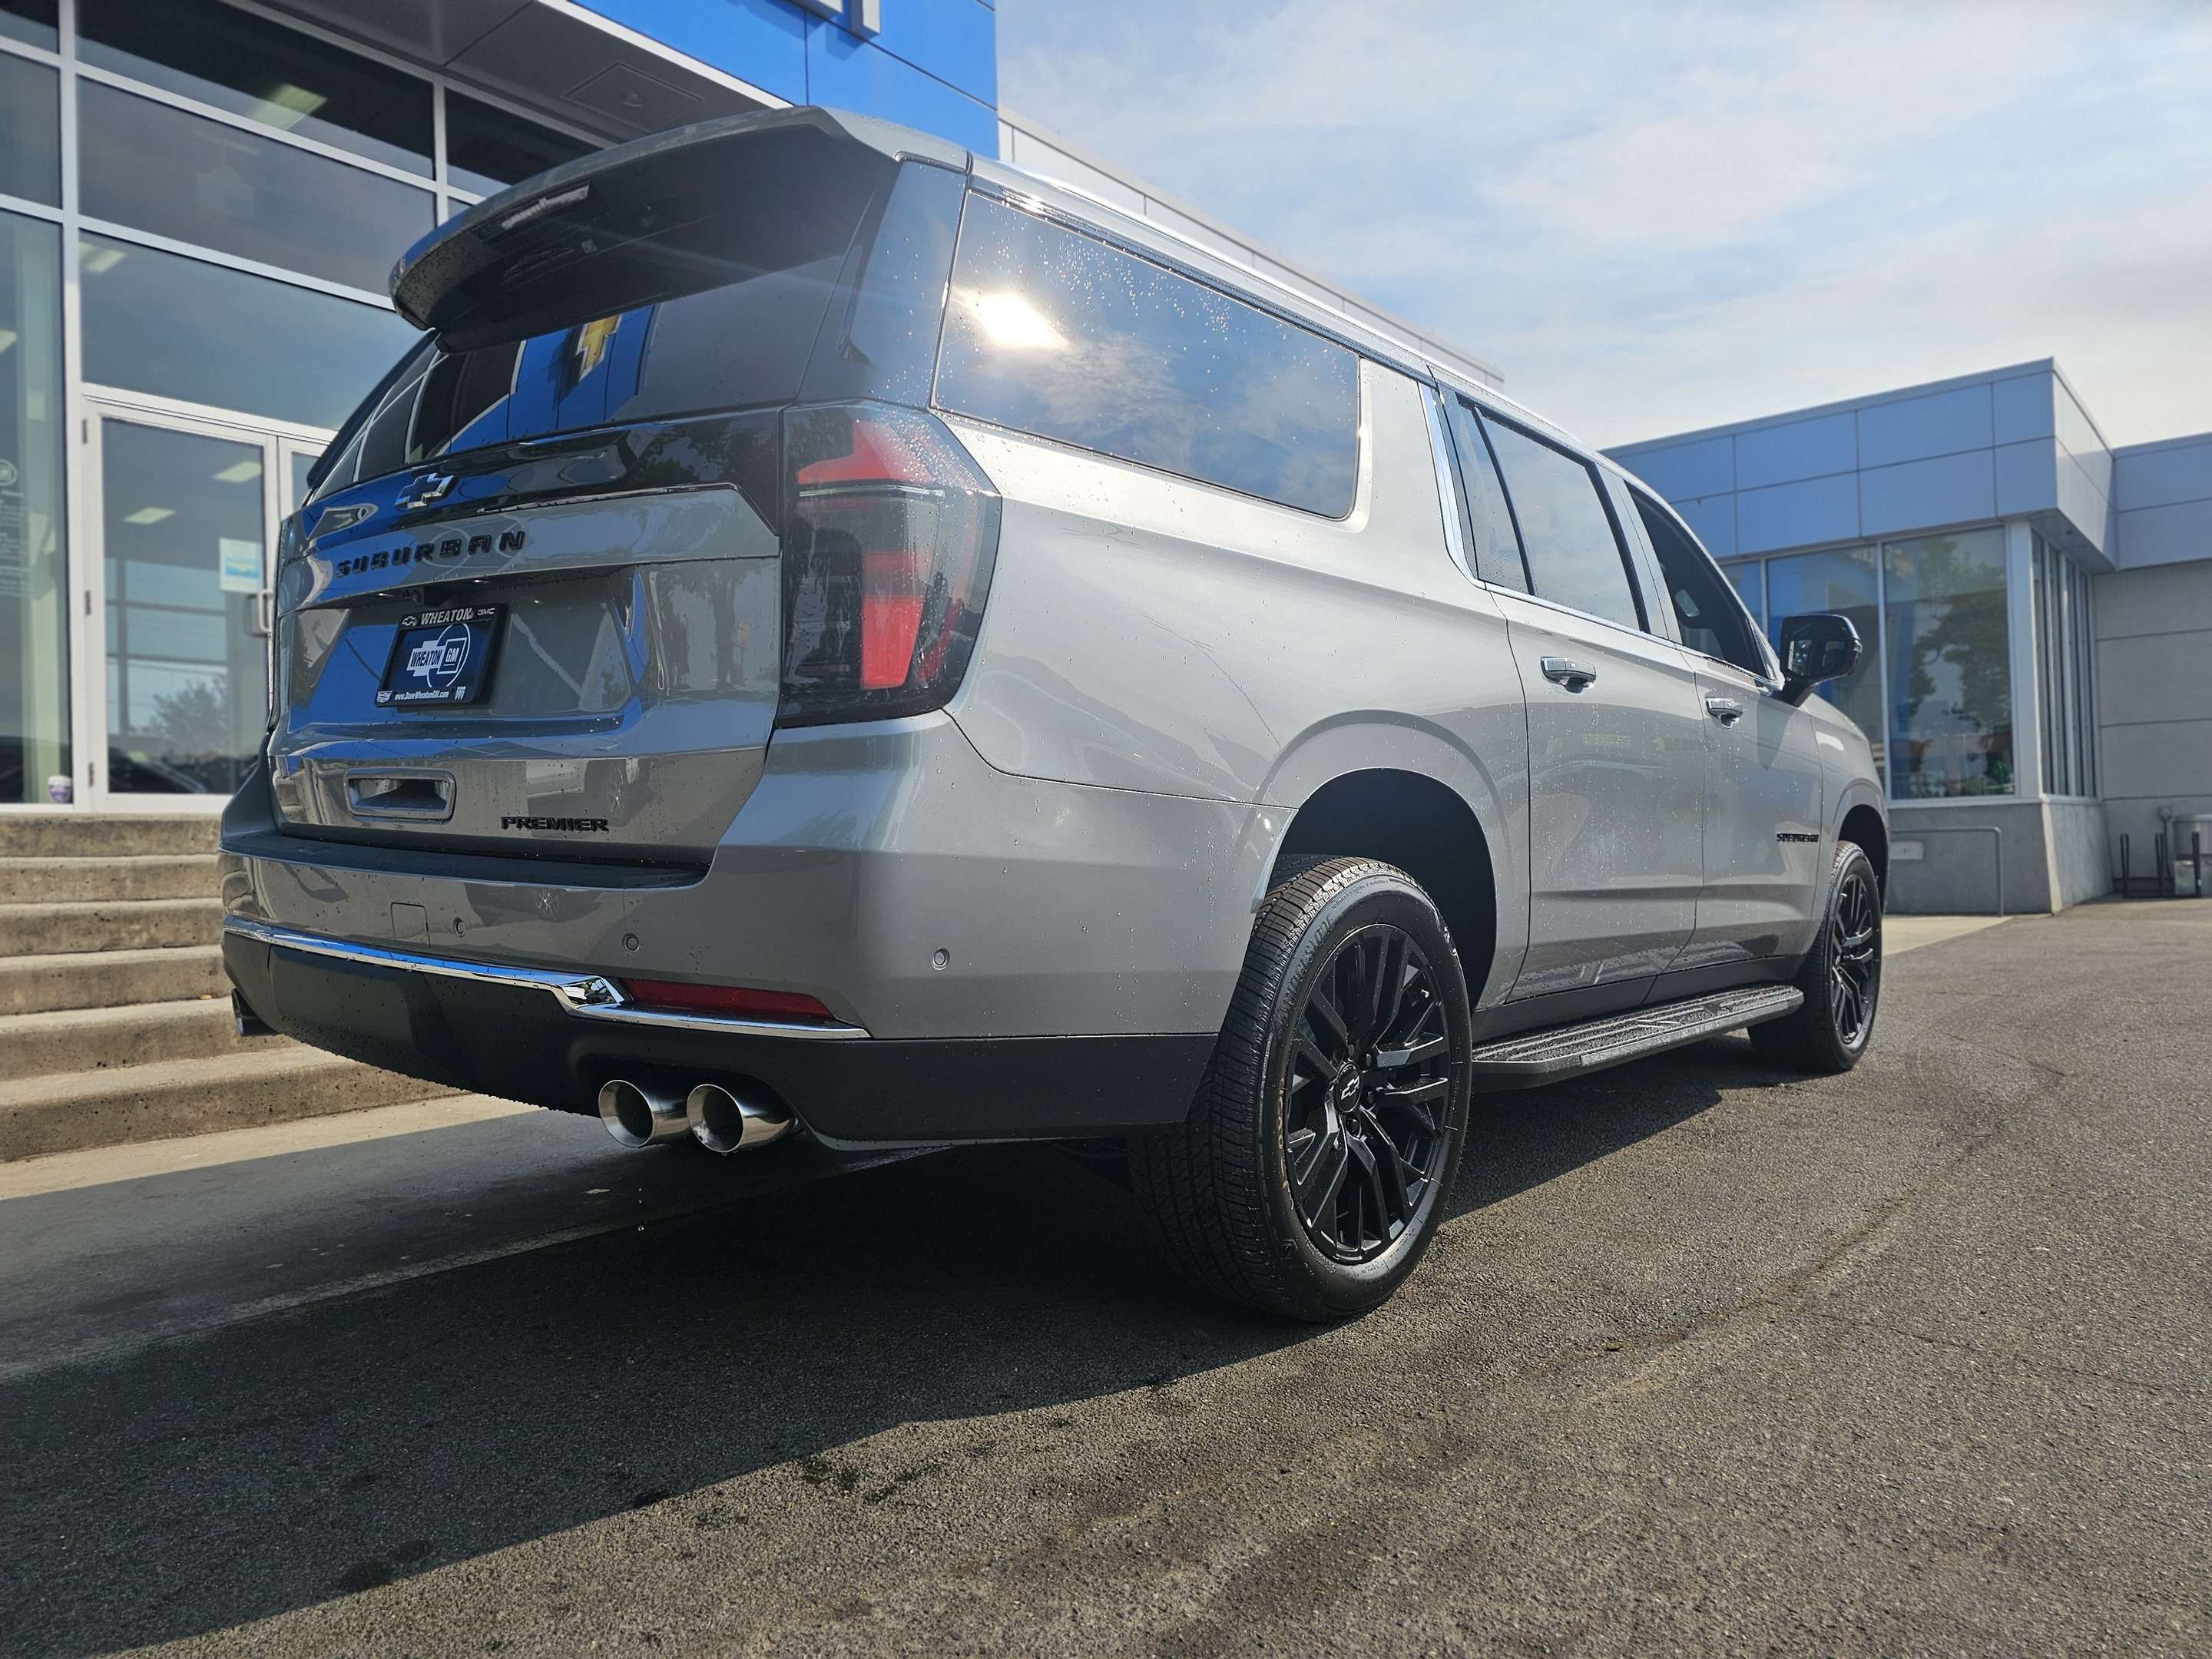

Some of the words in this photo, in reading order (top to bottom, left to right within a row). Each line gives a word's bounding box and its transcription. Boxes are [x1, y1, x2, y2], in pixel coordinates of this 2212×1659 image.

[334, 530, 525, 578] SUBURBAN
[420, 608, 473, 625] WHEATON
[477, 608, 495, 616] GMC
[410, 649, 443, 667] WHEATON
[445, 647, 460, 663] GM
[501, 816, 610, 833] PREMIER
